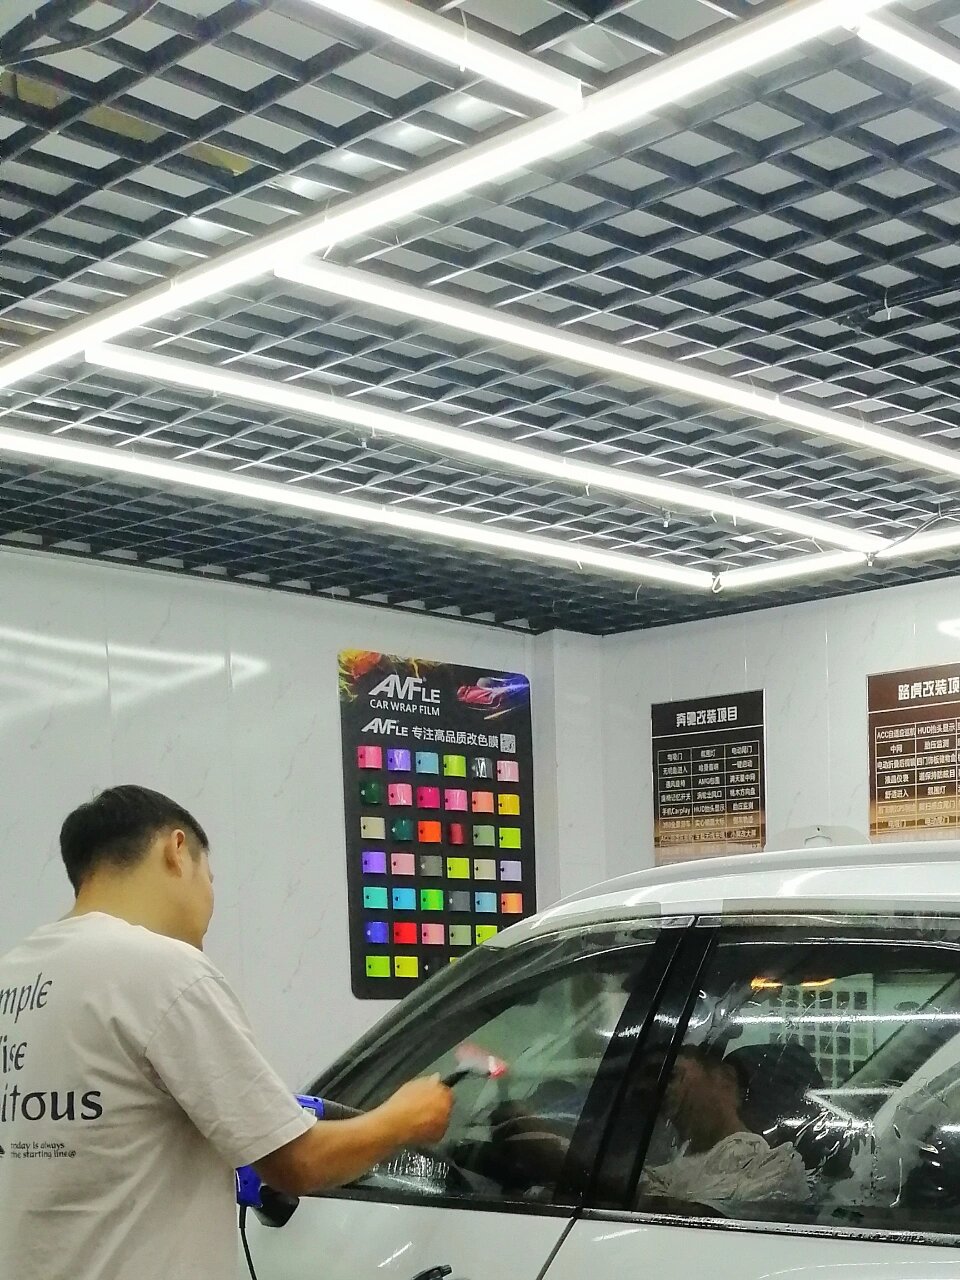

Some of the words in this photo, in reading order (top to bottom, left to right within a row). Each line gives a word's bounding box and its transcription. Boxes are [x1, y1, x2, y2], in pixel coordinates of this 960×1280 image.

[369, 699, 390, 711] CAR
[390, 701, 418, 713] WRAP
[419, 703, 440, 717] FILM
[676, 706, 737, 727] 奔驰改装项目
[411, 726, 499, 749] 专注高品质改色膜
